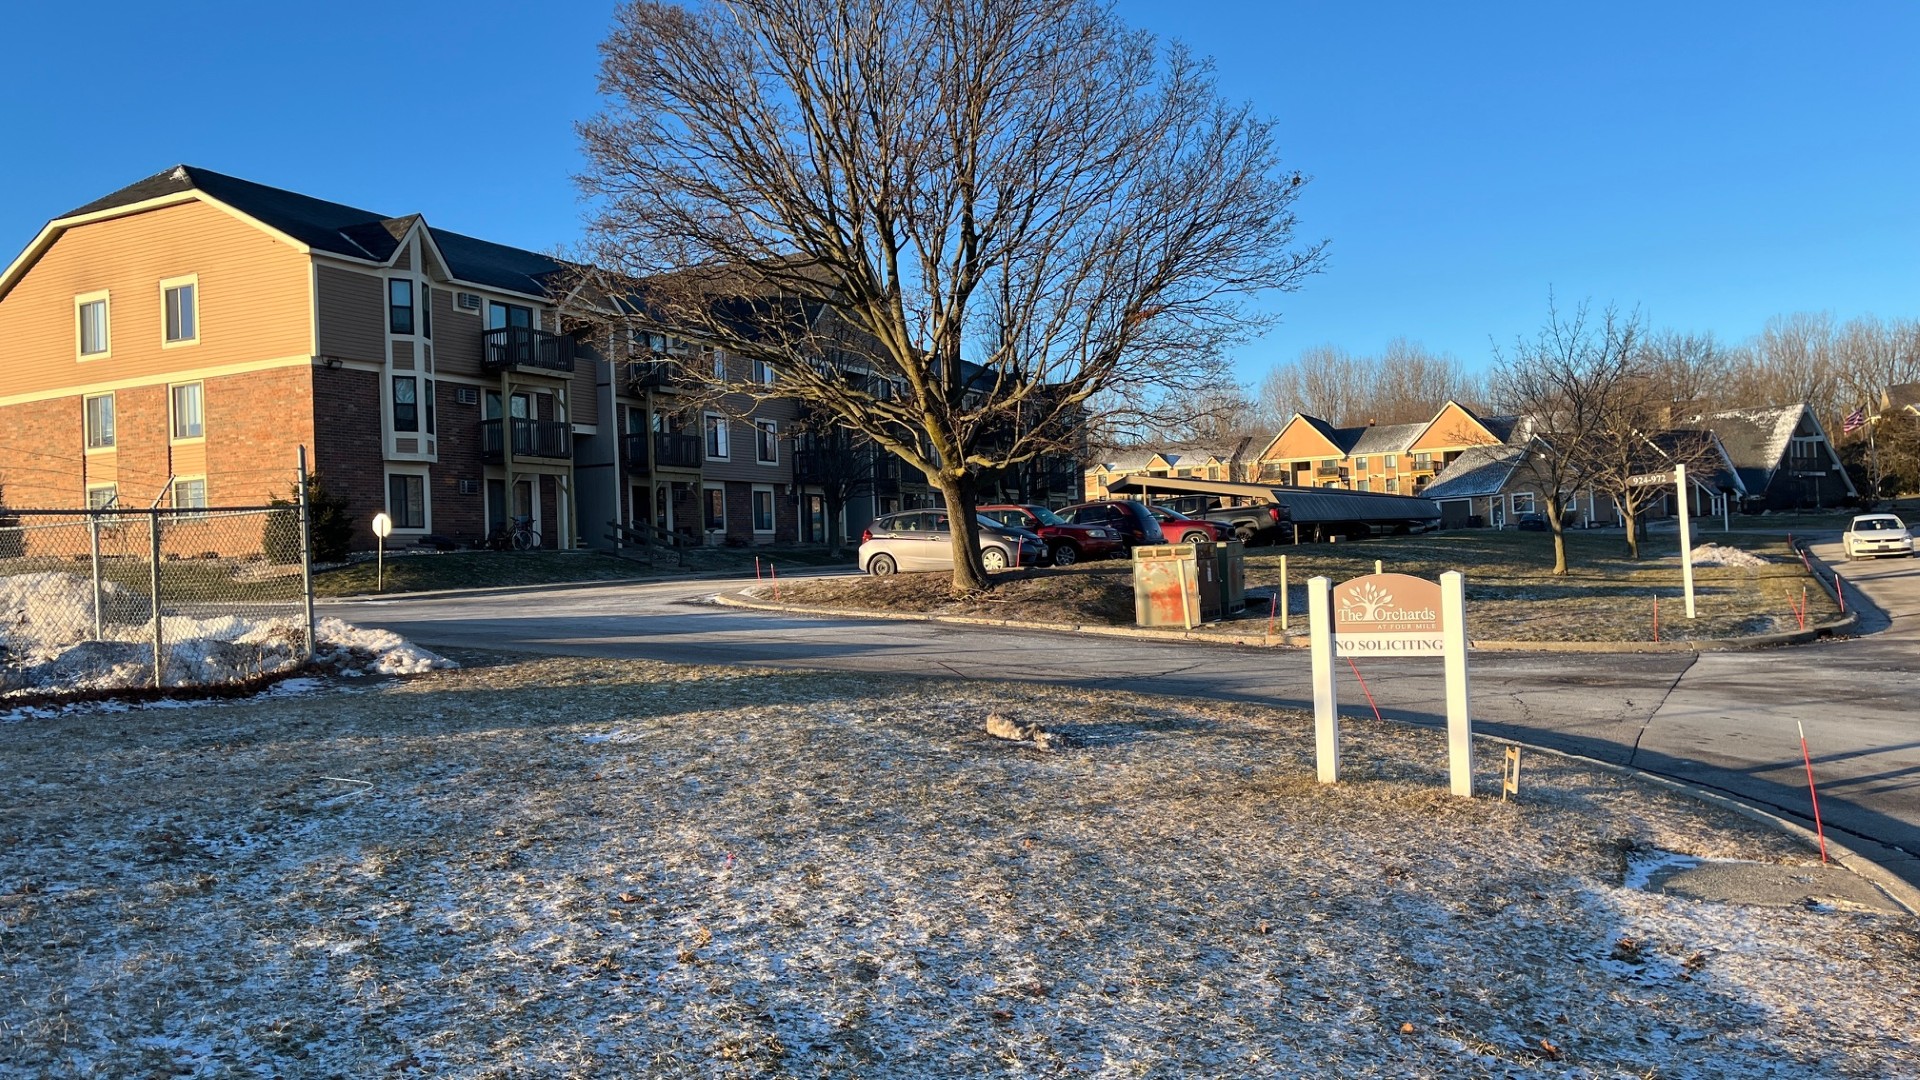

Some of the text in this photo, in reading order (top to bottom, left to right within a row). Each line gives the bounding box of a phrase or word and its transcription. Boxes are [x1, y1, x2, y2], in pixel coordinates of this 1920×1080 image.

[1633, 475, 1666, 485] 924-972
[1338, 607, 1436, 621] The Orchards
[1335, 639, 1443, 650] NO SOLICITING
